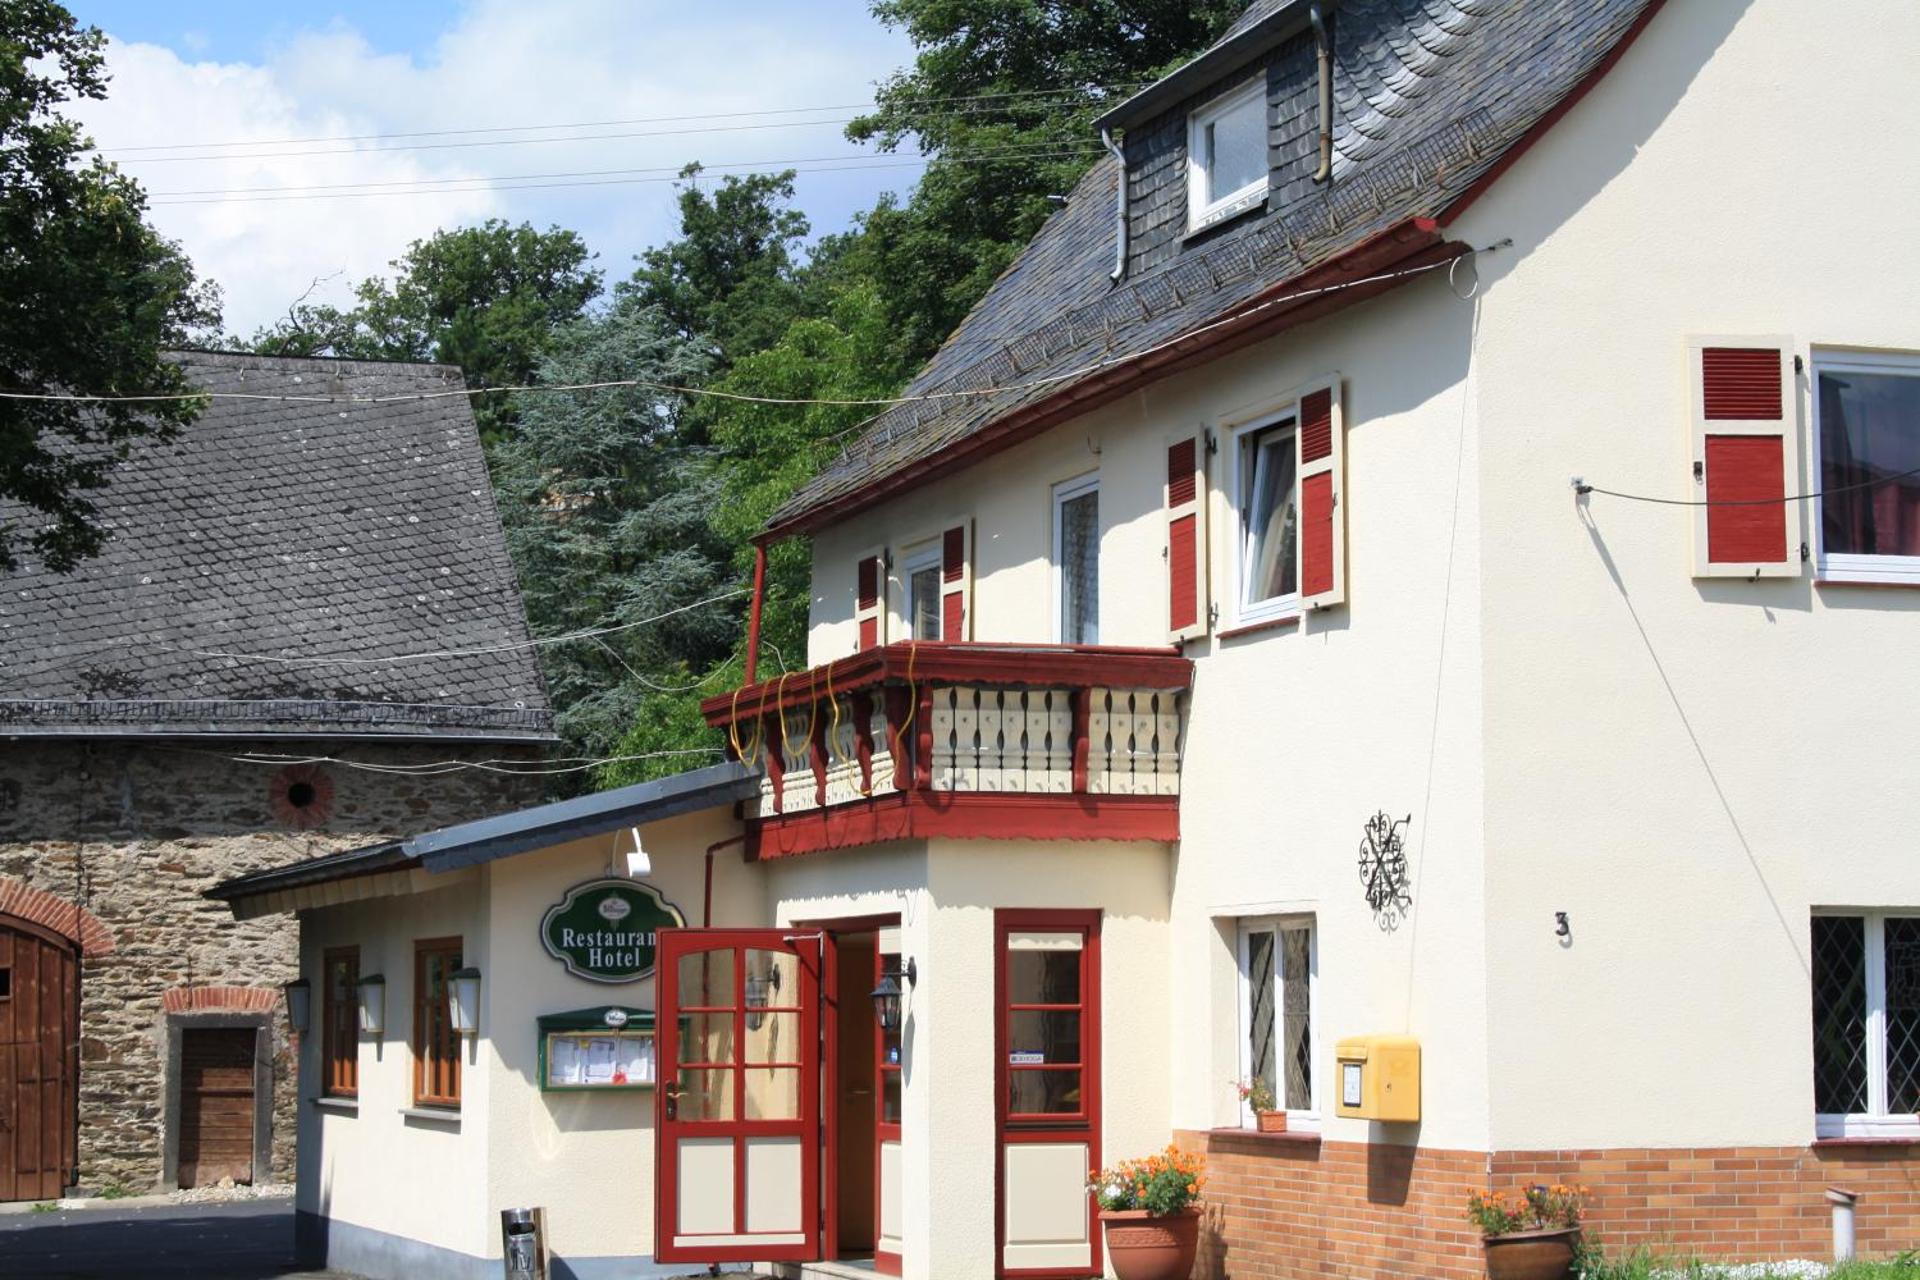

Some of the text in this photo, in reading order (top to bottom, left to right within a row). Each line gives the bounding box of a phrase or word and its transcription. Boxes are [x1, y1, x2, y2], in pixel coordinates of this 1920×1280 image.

[1555, 911, 1569, 936] 3
[562, 928, 656, 947] Restauran
[589, 948, 640, 967] Hotel
